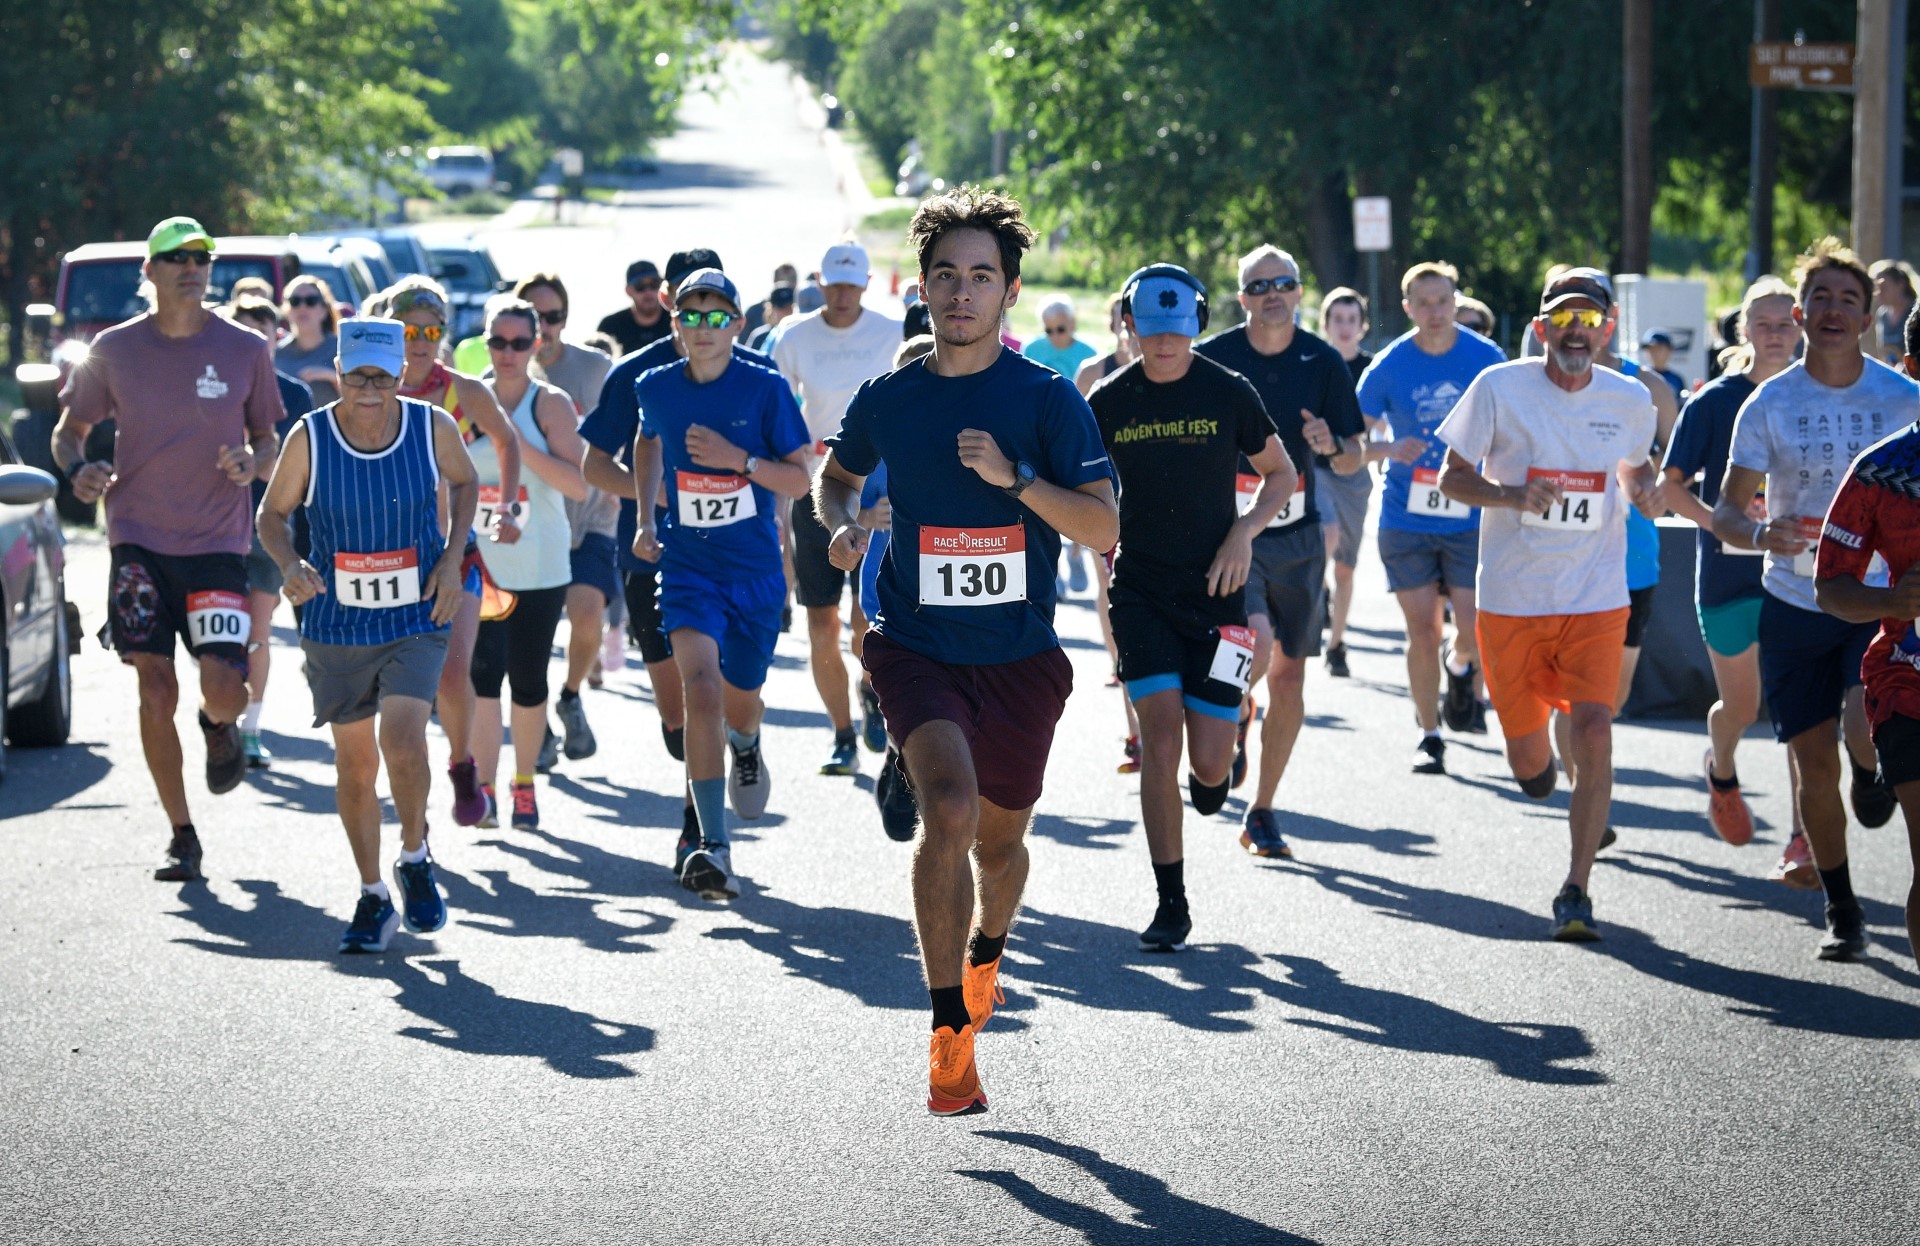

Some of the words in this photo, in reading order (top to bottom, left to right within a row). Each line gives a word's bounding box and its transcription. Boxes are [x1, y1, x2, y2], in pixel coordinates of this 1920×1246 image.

[1770, 67, 1801, 82] PARK
[1799, 412, 1883, 429] RAISE
[1114, 421, 1185, 443] ADVENTURE
[1188, 419, 1218, 436] FEST
[1799, 442, 1860, 456] YOU
[687, 478, 703, 489] RACE
[709, 480, 738, 489] RESULT
[1567, 477, 1595, 488] RESULT
[691, 496, 739, 521] 127
[934, 537, 959, 548] RACE
[971, 536, 1008, 548] RESULT
[345, 559, 364, 568] RACE
[373, 557, 403, 567] RESULT
[937, 562, 1007, 597] 130
[350, 576, 399, 601] 111
[198, 614, 240, 636] 100
